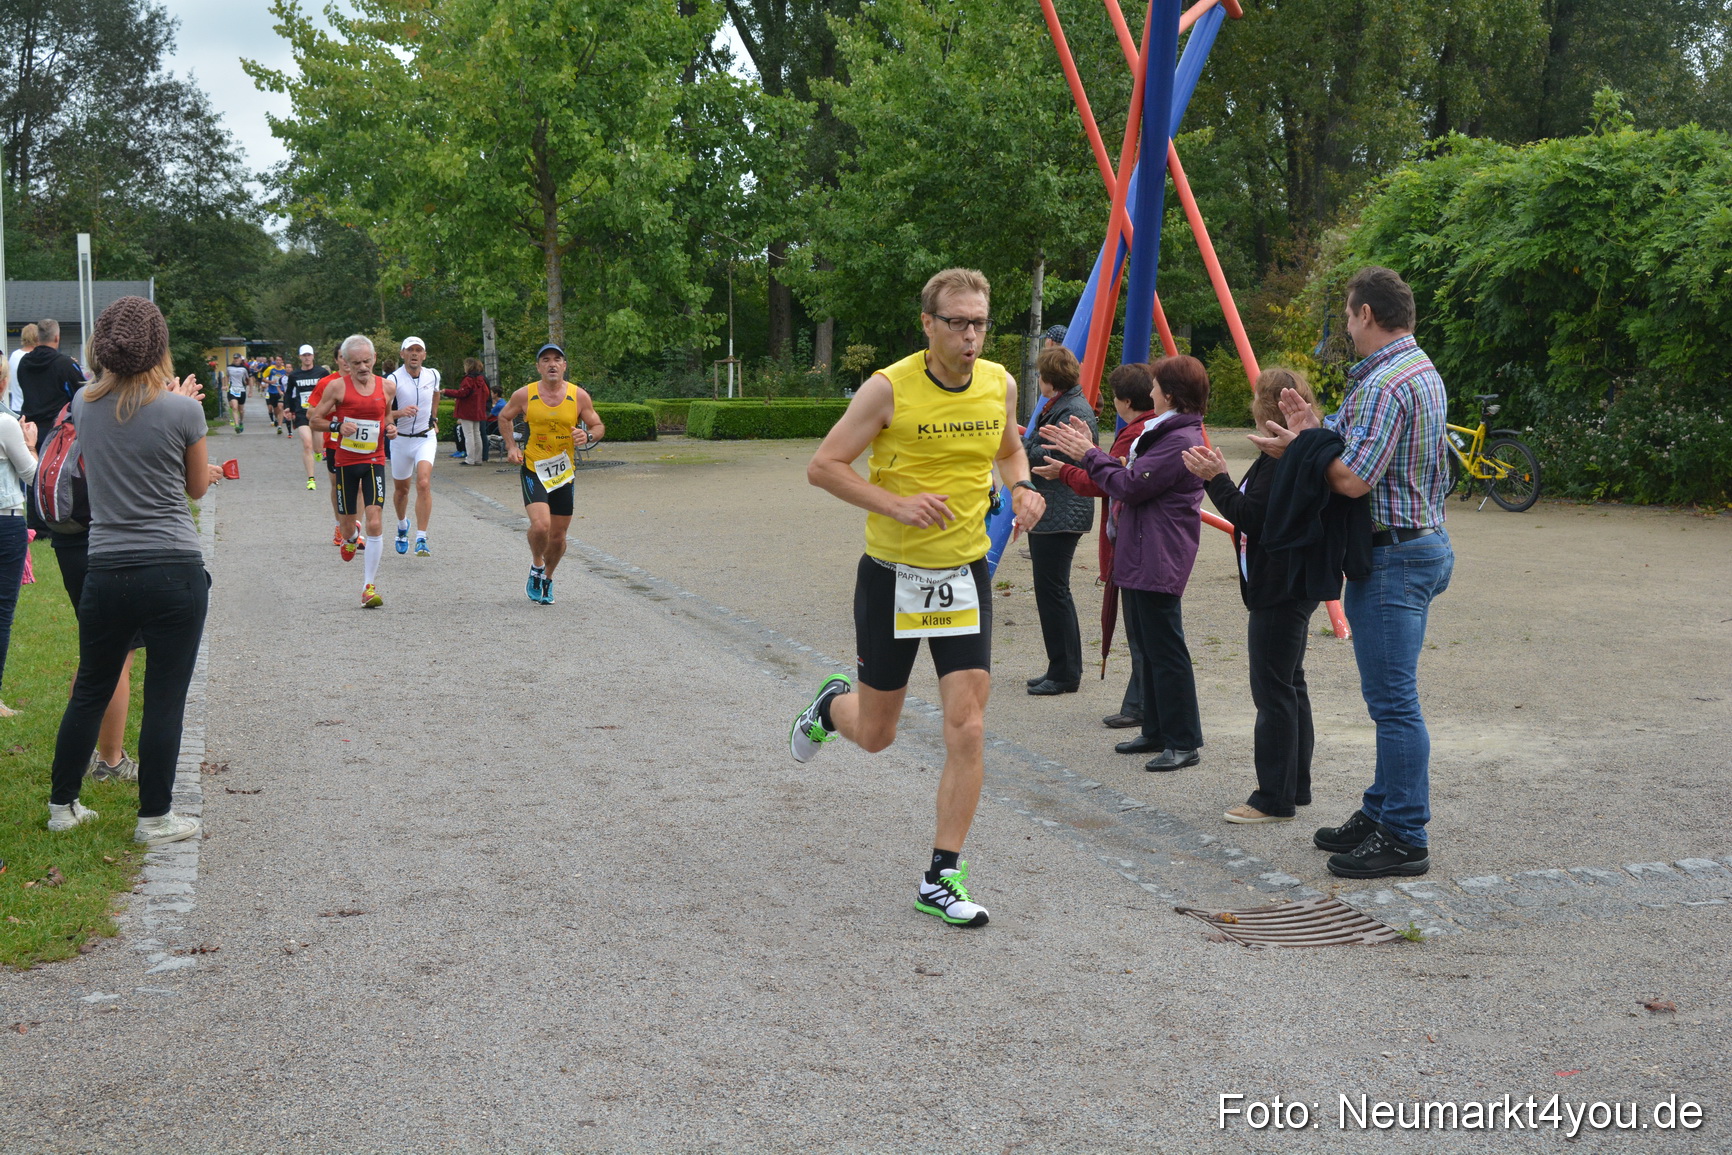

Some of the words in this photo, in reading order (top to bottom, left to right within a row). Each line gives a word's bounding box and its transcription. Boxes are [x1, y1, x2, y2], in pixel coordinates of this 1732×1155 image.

[918, 419, 999, 434] KLINGELE
[355, 428, 368, 441] 15
[544, 461, 566, 478] 176
[897, 571, 926, 584] PARTL
[920, 582, 954, 609] 79
[922, 615, 952, 626] Klaus
